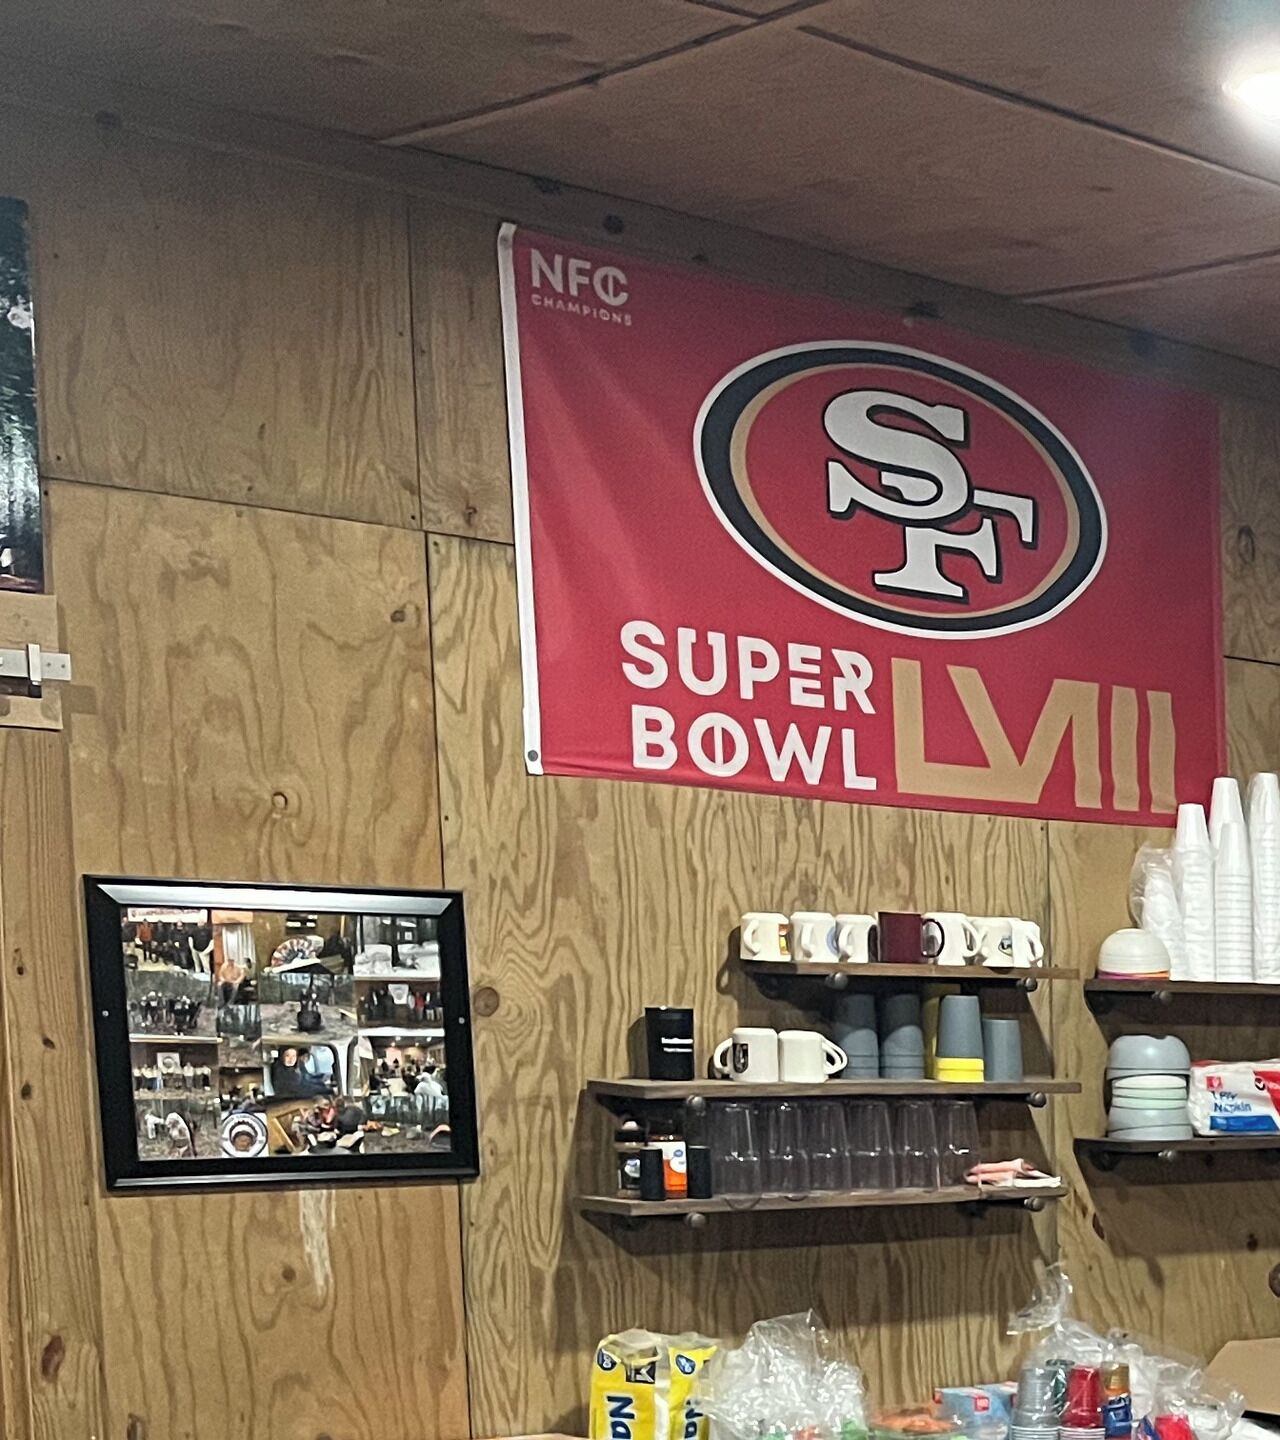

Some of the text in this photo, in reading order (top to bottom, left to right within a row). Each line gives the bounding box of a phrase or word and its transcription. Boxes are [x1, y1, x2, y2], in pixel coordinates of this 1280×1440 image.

[531, 248, 629, 307] NFC
[531, 294, 632, 326] CHAMPIONS
[823, 389, 1037, 600] SF
[620, 620, 876, 716] SUPER
[630, 703, 878, 792] BOWL
